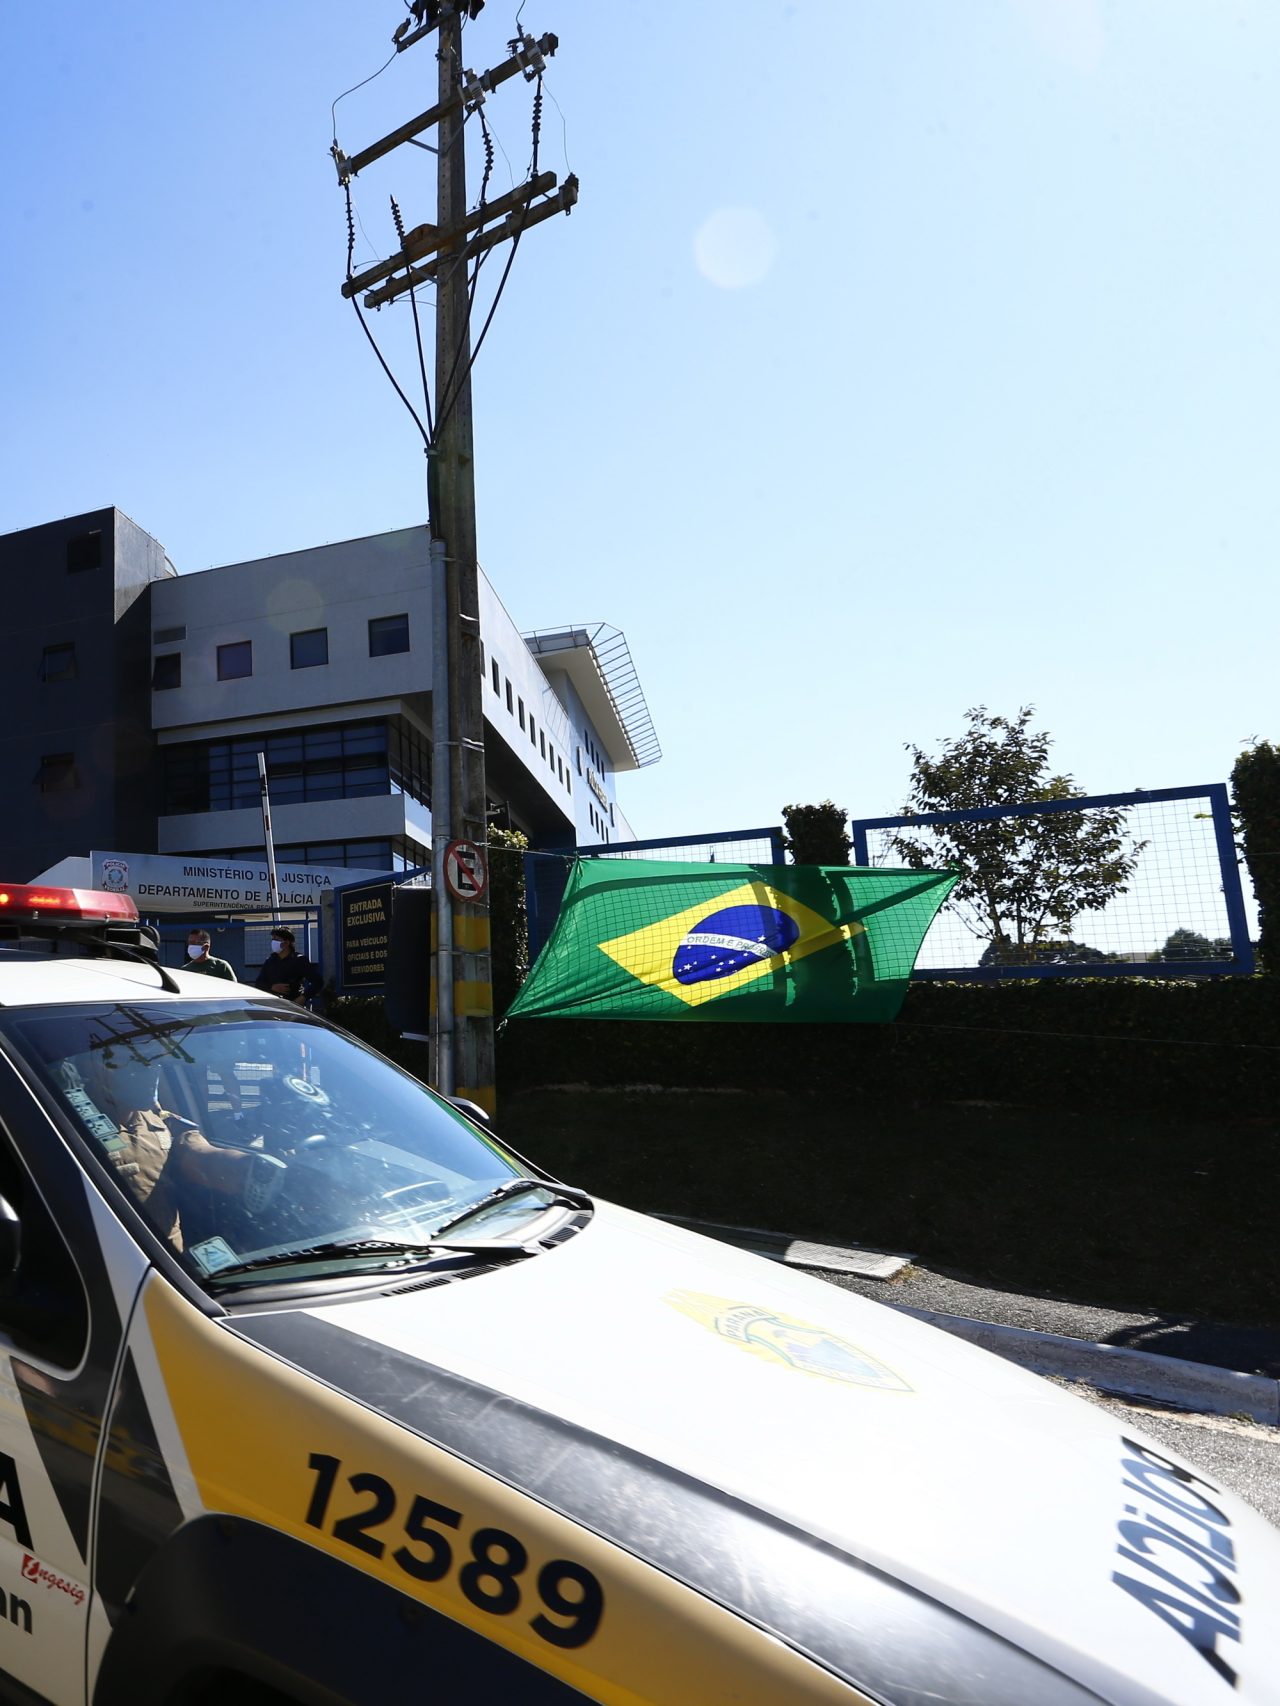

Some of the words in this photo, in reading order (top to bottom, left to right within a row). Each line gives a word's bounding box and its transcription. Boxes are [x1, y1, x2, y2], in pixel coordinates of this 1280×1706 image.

[183, 866, 254, 881] MINISTÉRIO
[259, 871, 270, 882] D
[281, 872, 332, 887] JUSTIÇA
[456, 850, 477, 891] E
[138, 884, 240, 900] DEPARTAMENTO
[245, 890, 262, 902] DE
[349, 898, 383, 913] ENTRADA
[347, 911, 386, 927] EXCLUSIVA
[346, 939, 361, 949] PARA
[360, 935, 388, 947] VEÍCULOS
[687, 936, 725, 945] ORDEM
[727, 939, 734, 947] E
[347, 951, 370, 962] OFICIAIS
[370, 951, 375, 959] E
[375, 949, 388, 958] DOS
[350, 963, 385, 974] SERVIDORES
[305, 1452, 605, 1650] 12589
